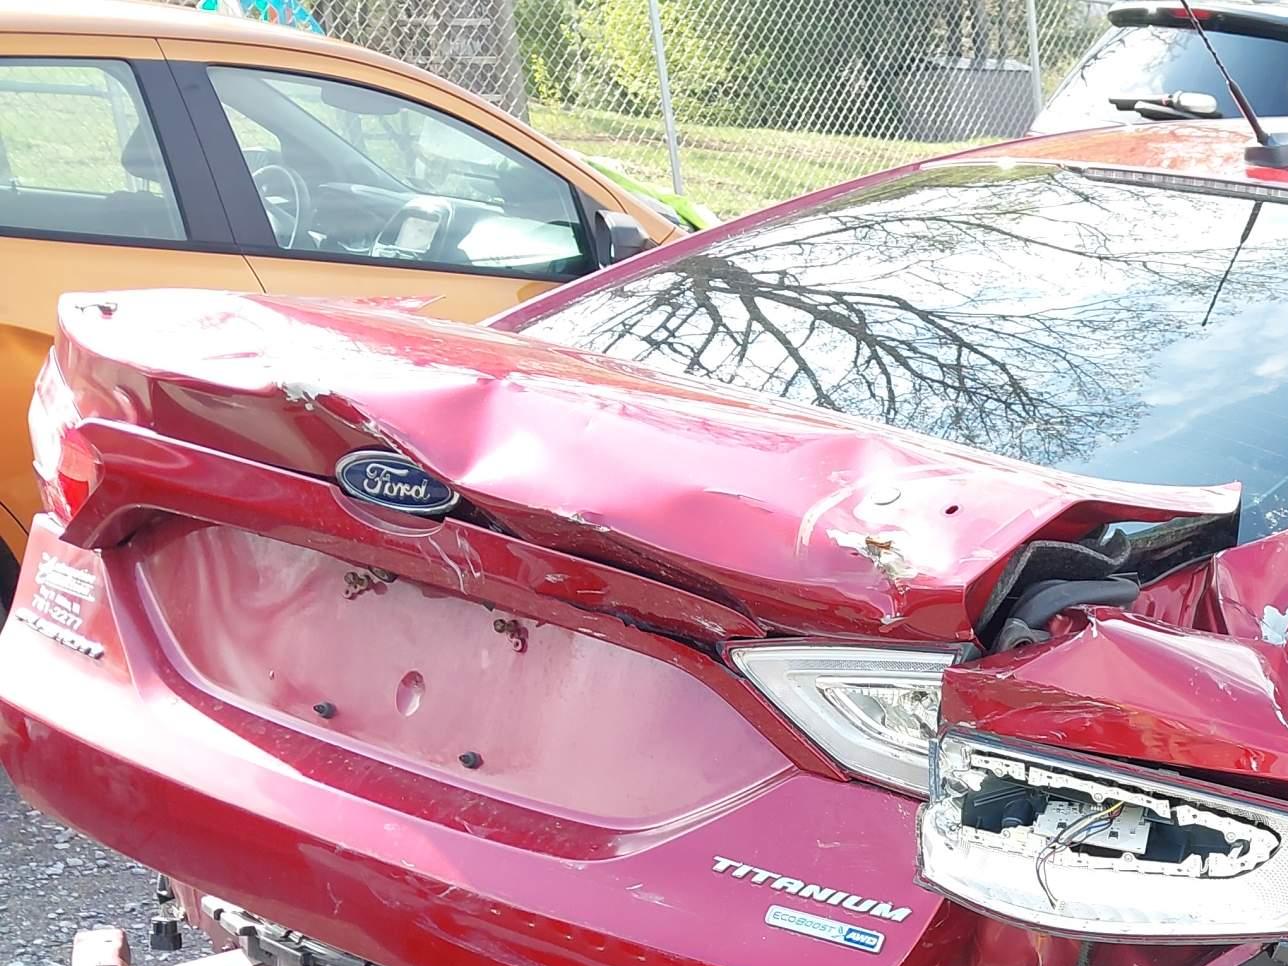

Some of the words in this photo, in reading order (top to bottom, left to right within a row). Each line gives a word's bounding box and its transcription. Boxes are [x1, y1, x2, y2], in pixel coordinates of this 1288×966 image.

[363, 463, 431, 499] Ford
[711, 855, 913, 923] TITANIUM
[771, 910, 836, 934] ECOBOOST
[845, 930, 880, 947] AWD
